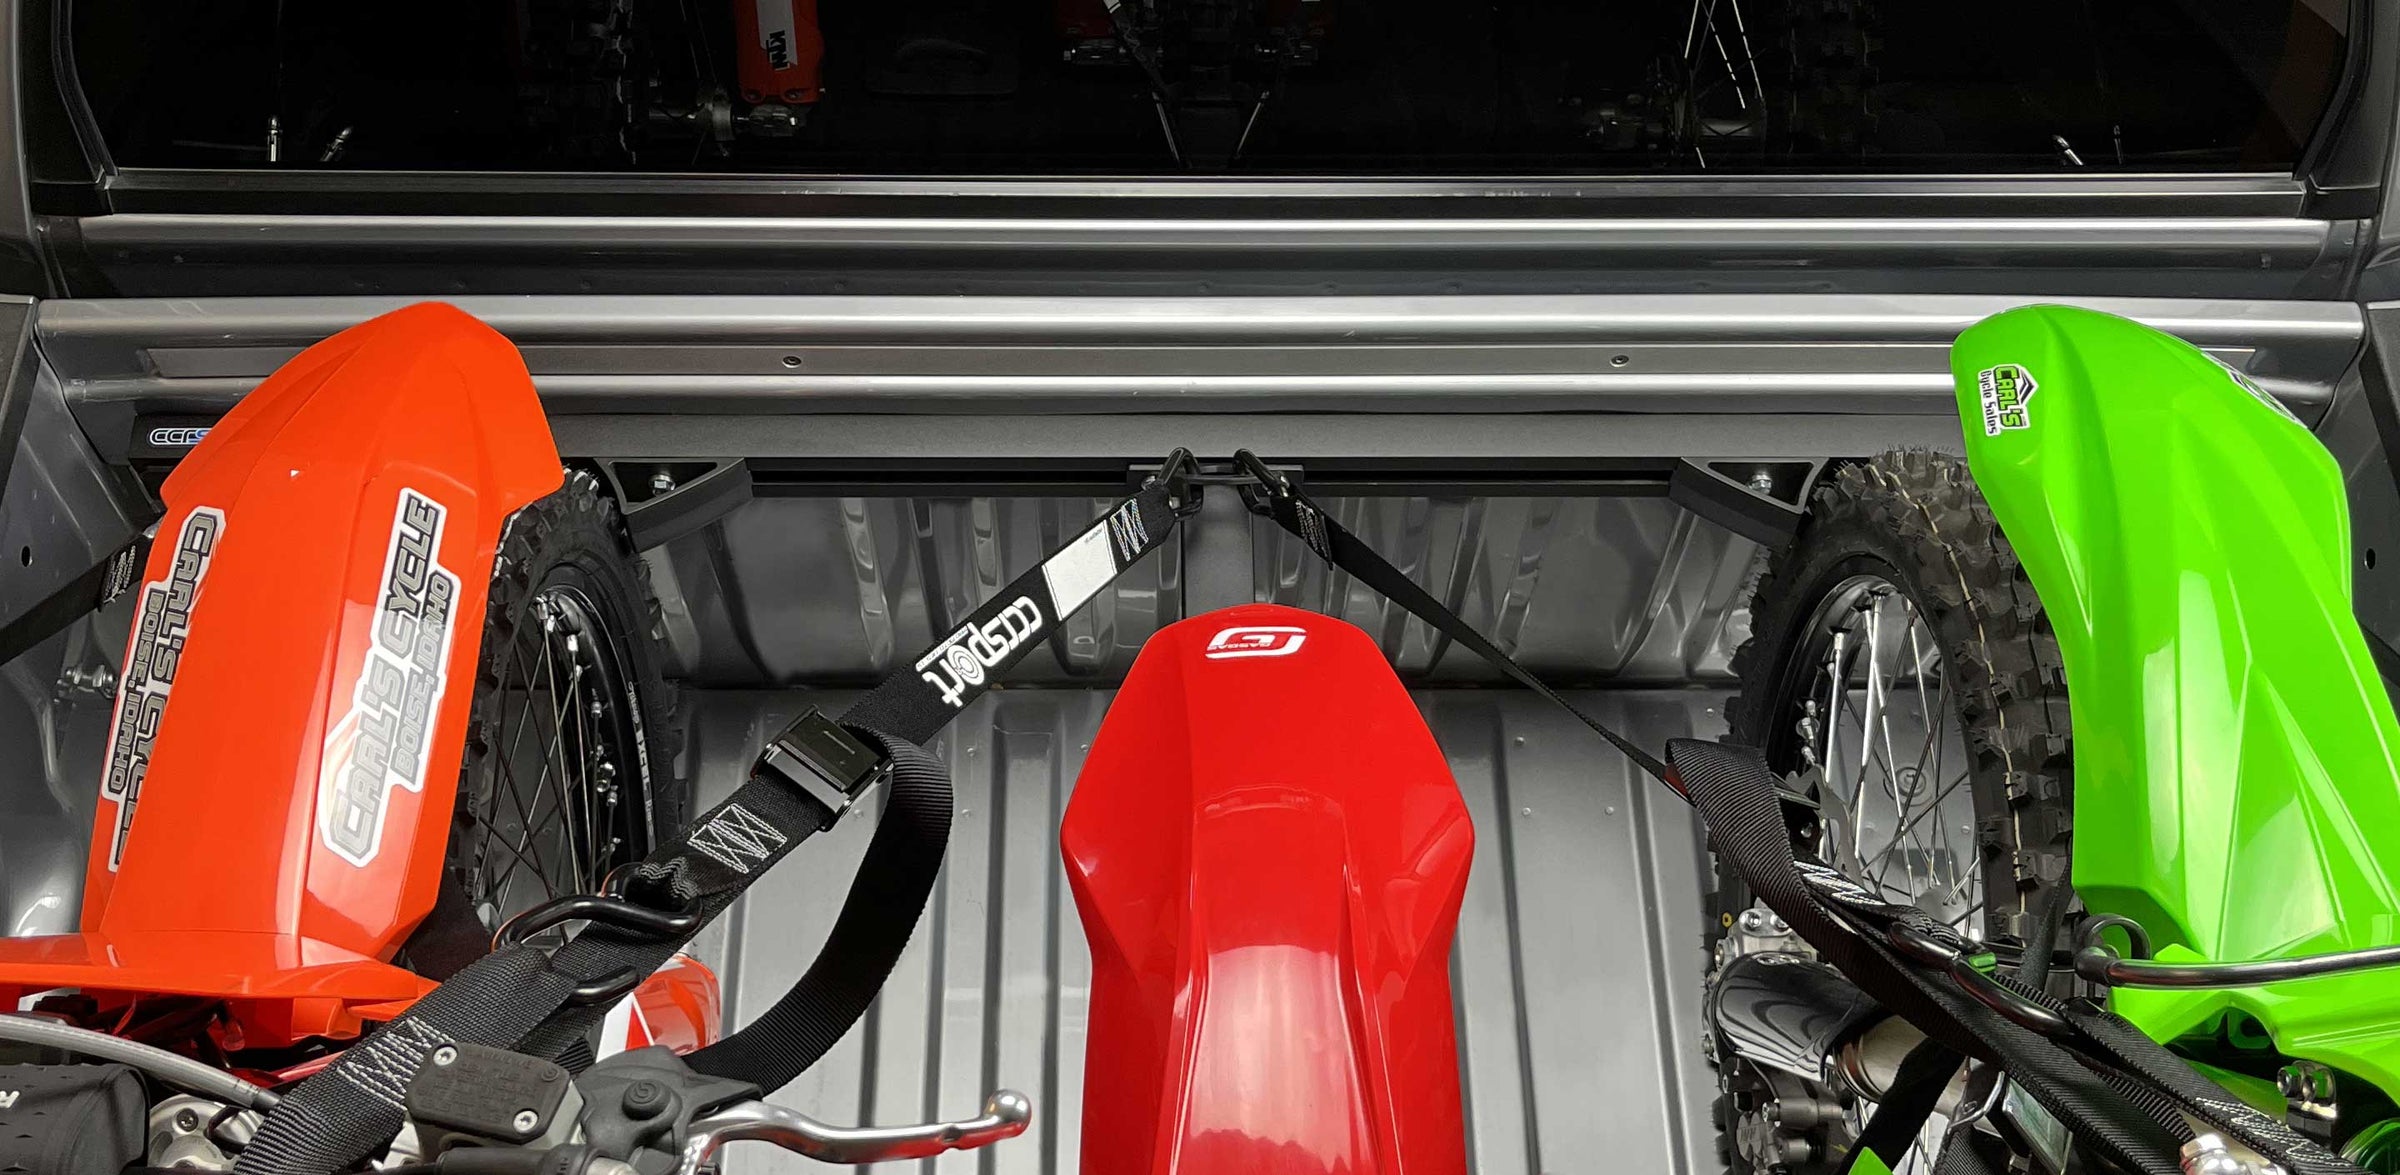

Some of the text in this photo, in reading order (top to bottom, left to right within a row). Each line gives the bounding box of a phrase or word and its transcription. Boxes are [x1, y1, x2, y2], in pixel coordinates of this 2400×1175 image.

[1980, 370, 1998, 434] Cycle Sales
[1993, 366, 2024, 427] CARL'S
[150, 512, 217, 684] CARL'S
[412, 570, 454, 671] IDAHO
[329, 493, 440, 859] CARL'S CYCLE
[108, 690, 144, 794] IDAHO
